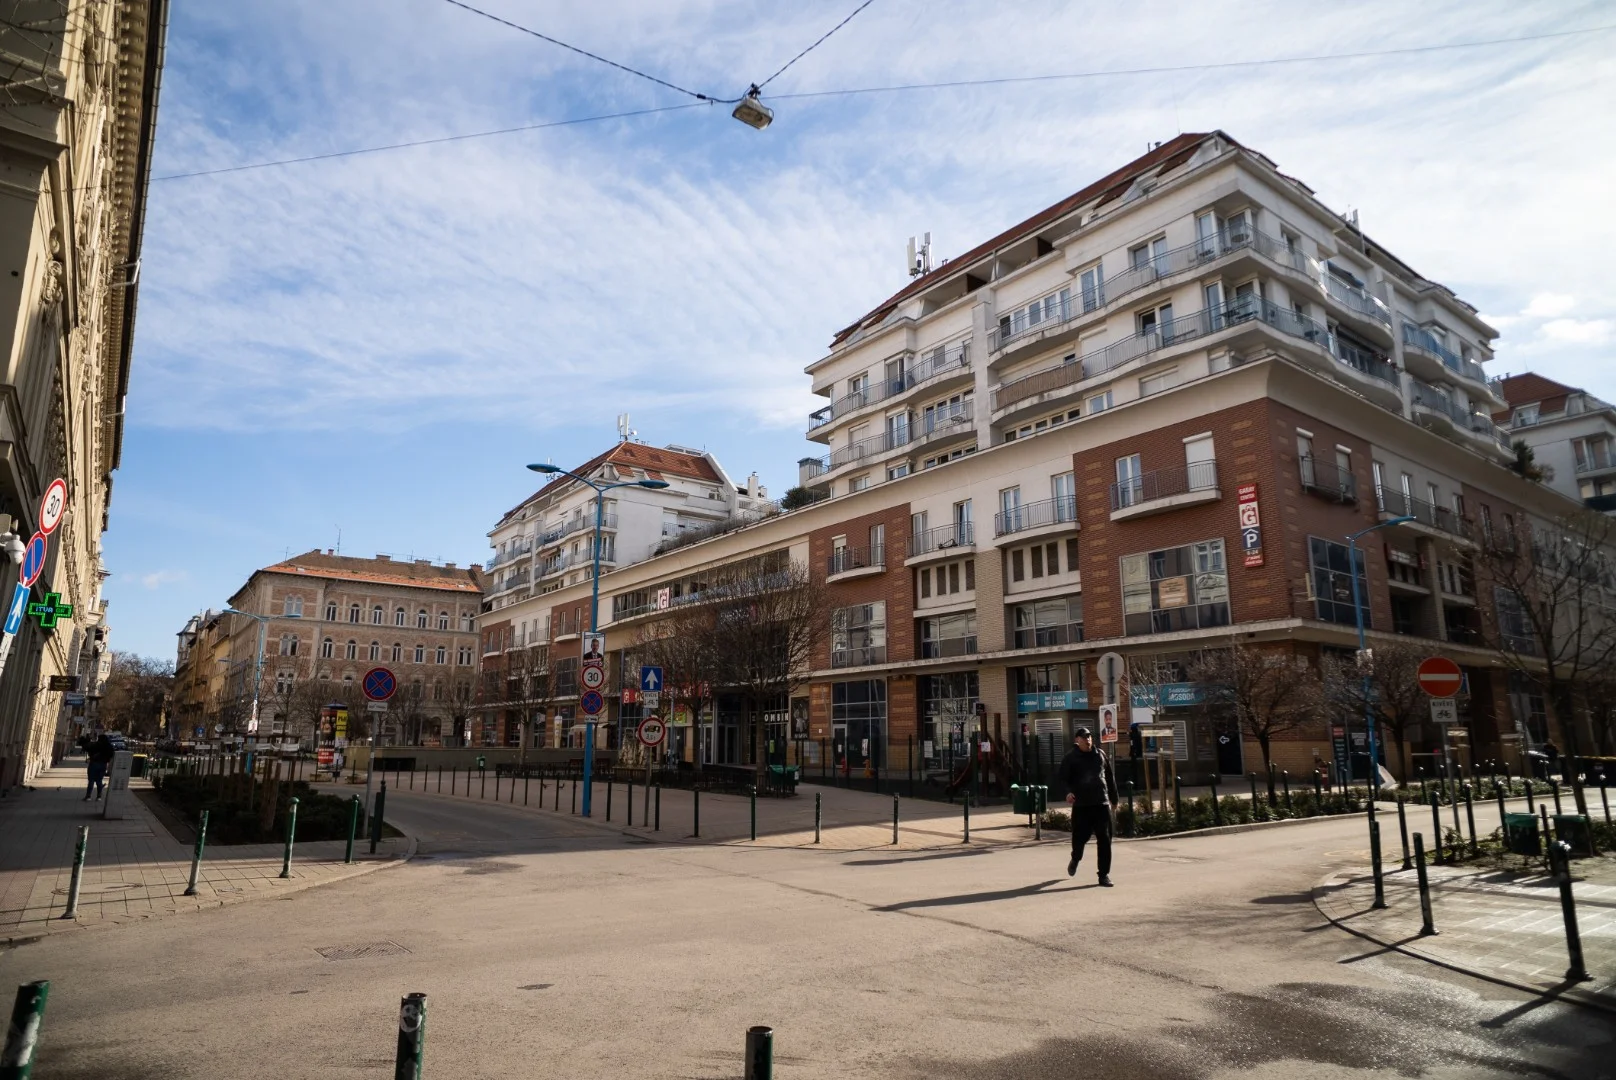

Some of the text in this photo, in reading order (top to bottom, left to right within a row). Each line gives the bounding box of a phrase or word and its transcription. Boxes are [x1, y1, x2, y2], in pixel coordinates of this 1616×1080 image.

[46, 495, 60, 516] 30
[1243, 510, 1256, 525] G
[1246, 534, 1258, 548] P
[587, 672, 598, 682] 30
